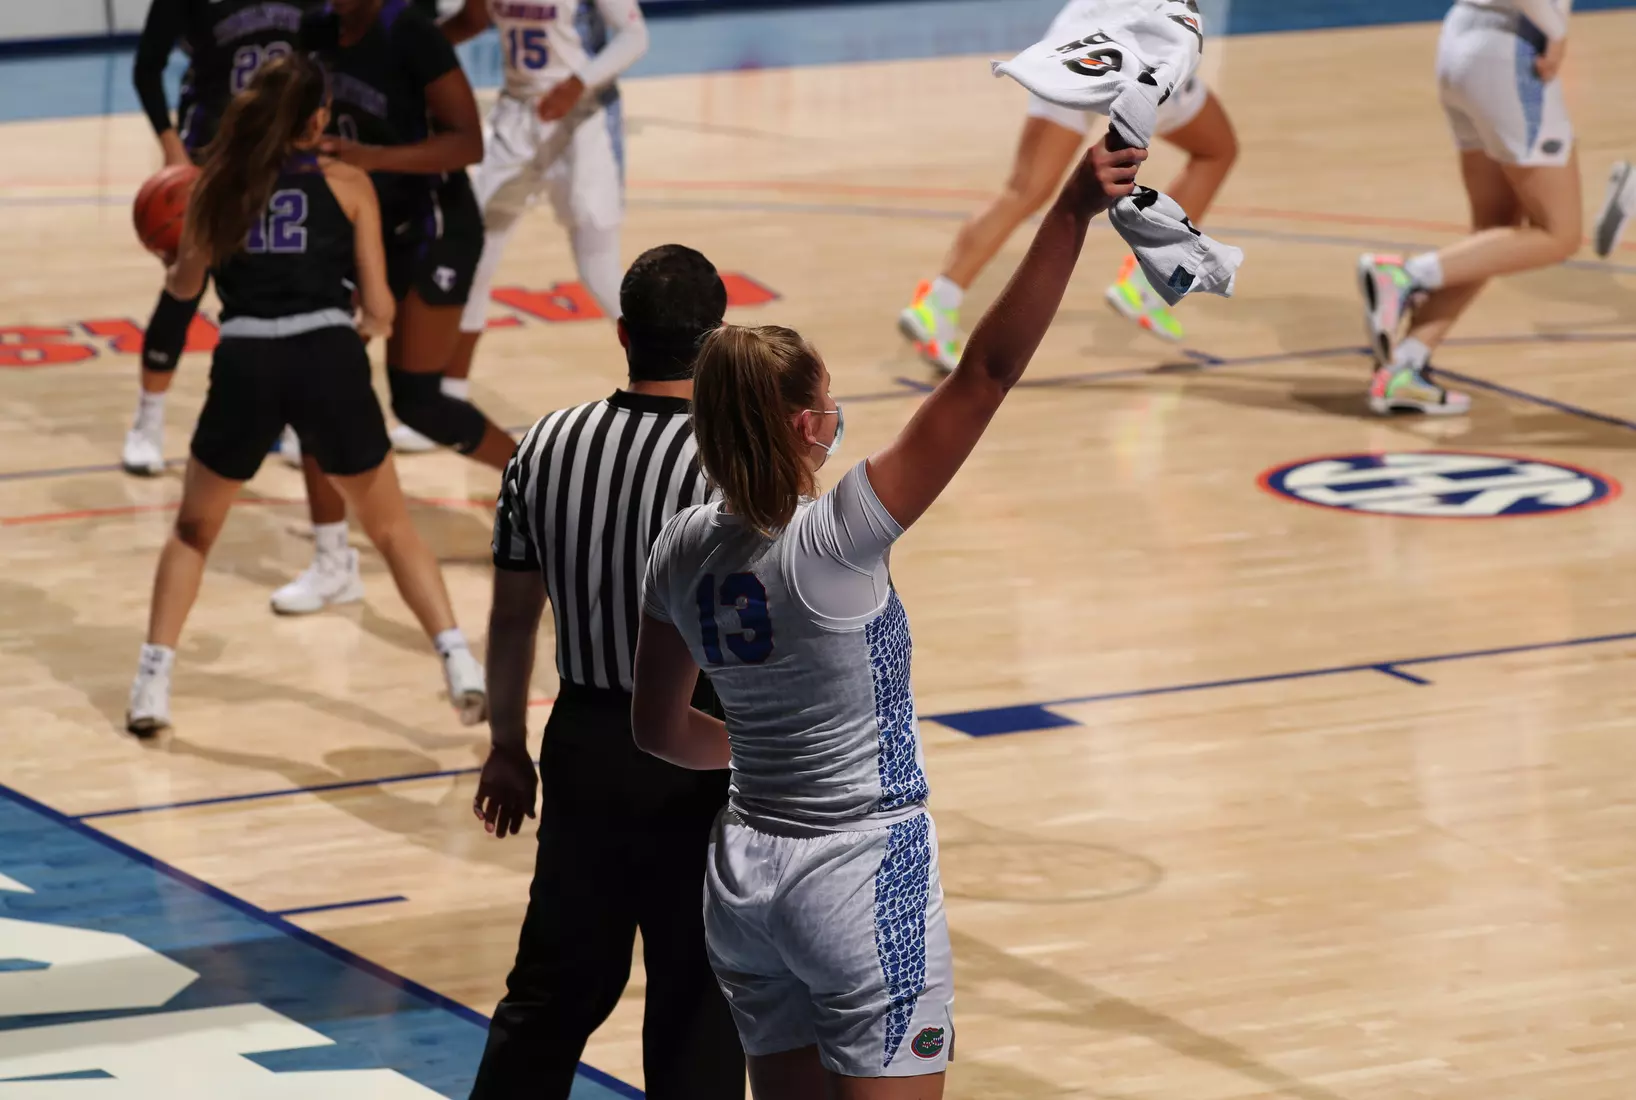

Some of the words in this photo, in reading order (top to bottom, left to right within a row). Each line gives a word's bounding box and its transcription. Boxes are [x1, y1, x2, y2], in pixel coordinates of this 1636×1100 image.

[508, 27, 549, 70] 15
[245, 188, 308, 254] 12
[696, 571, 775, 665] 13
